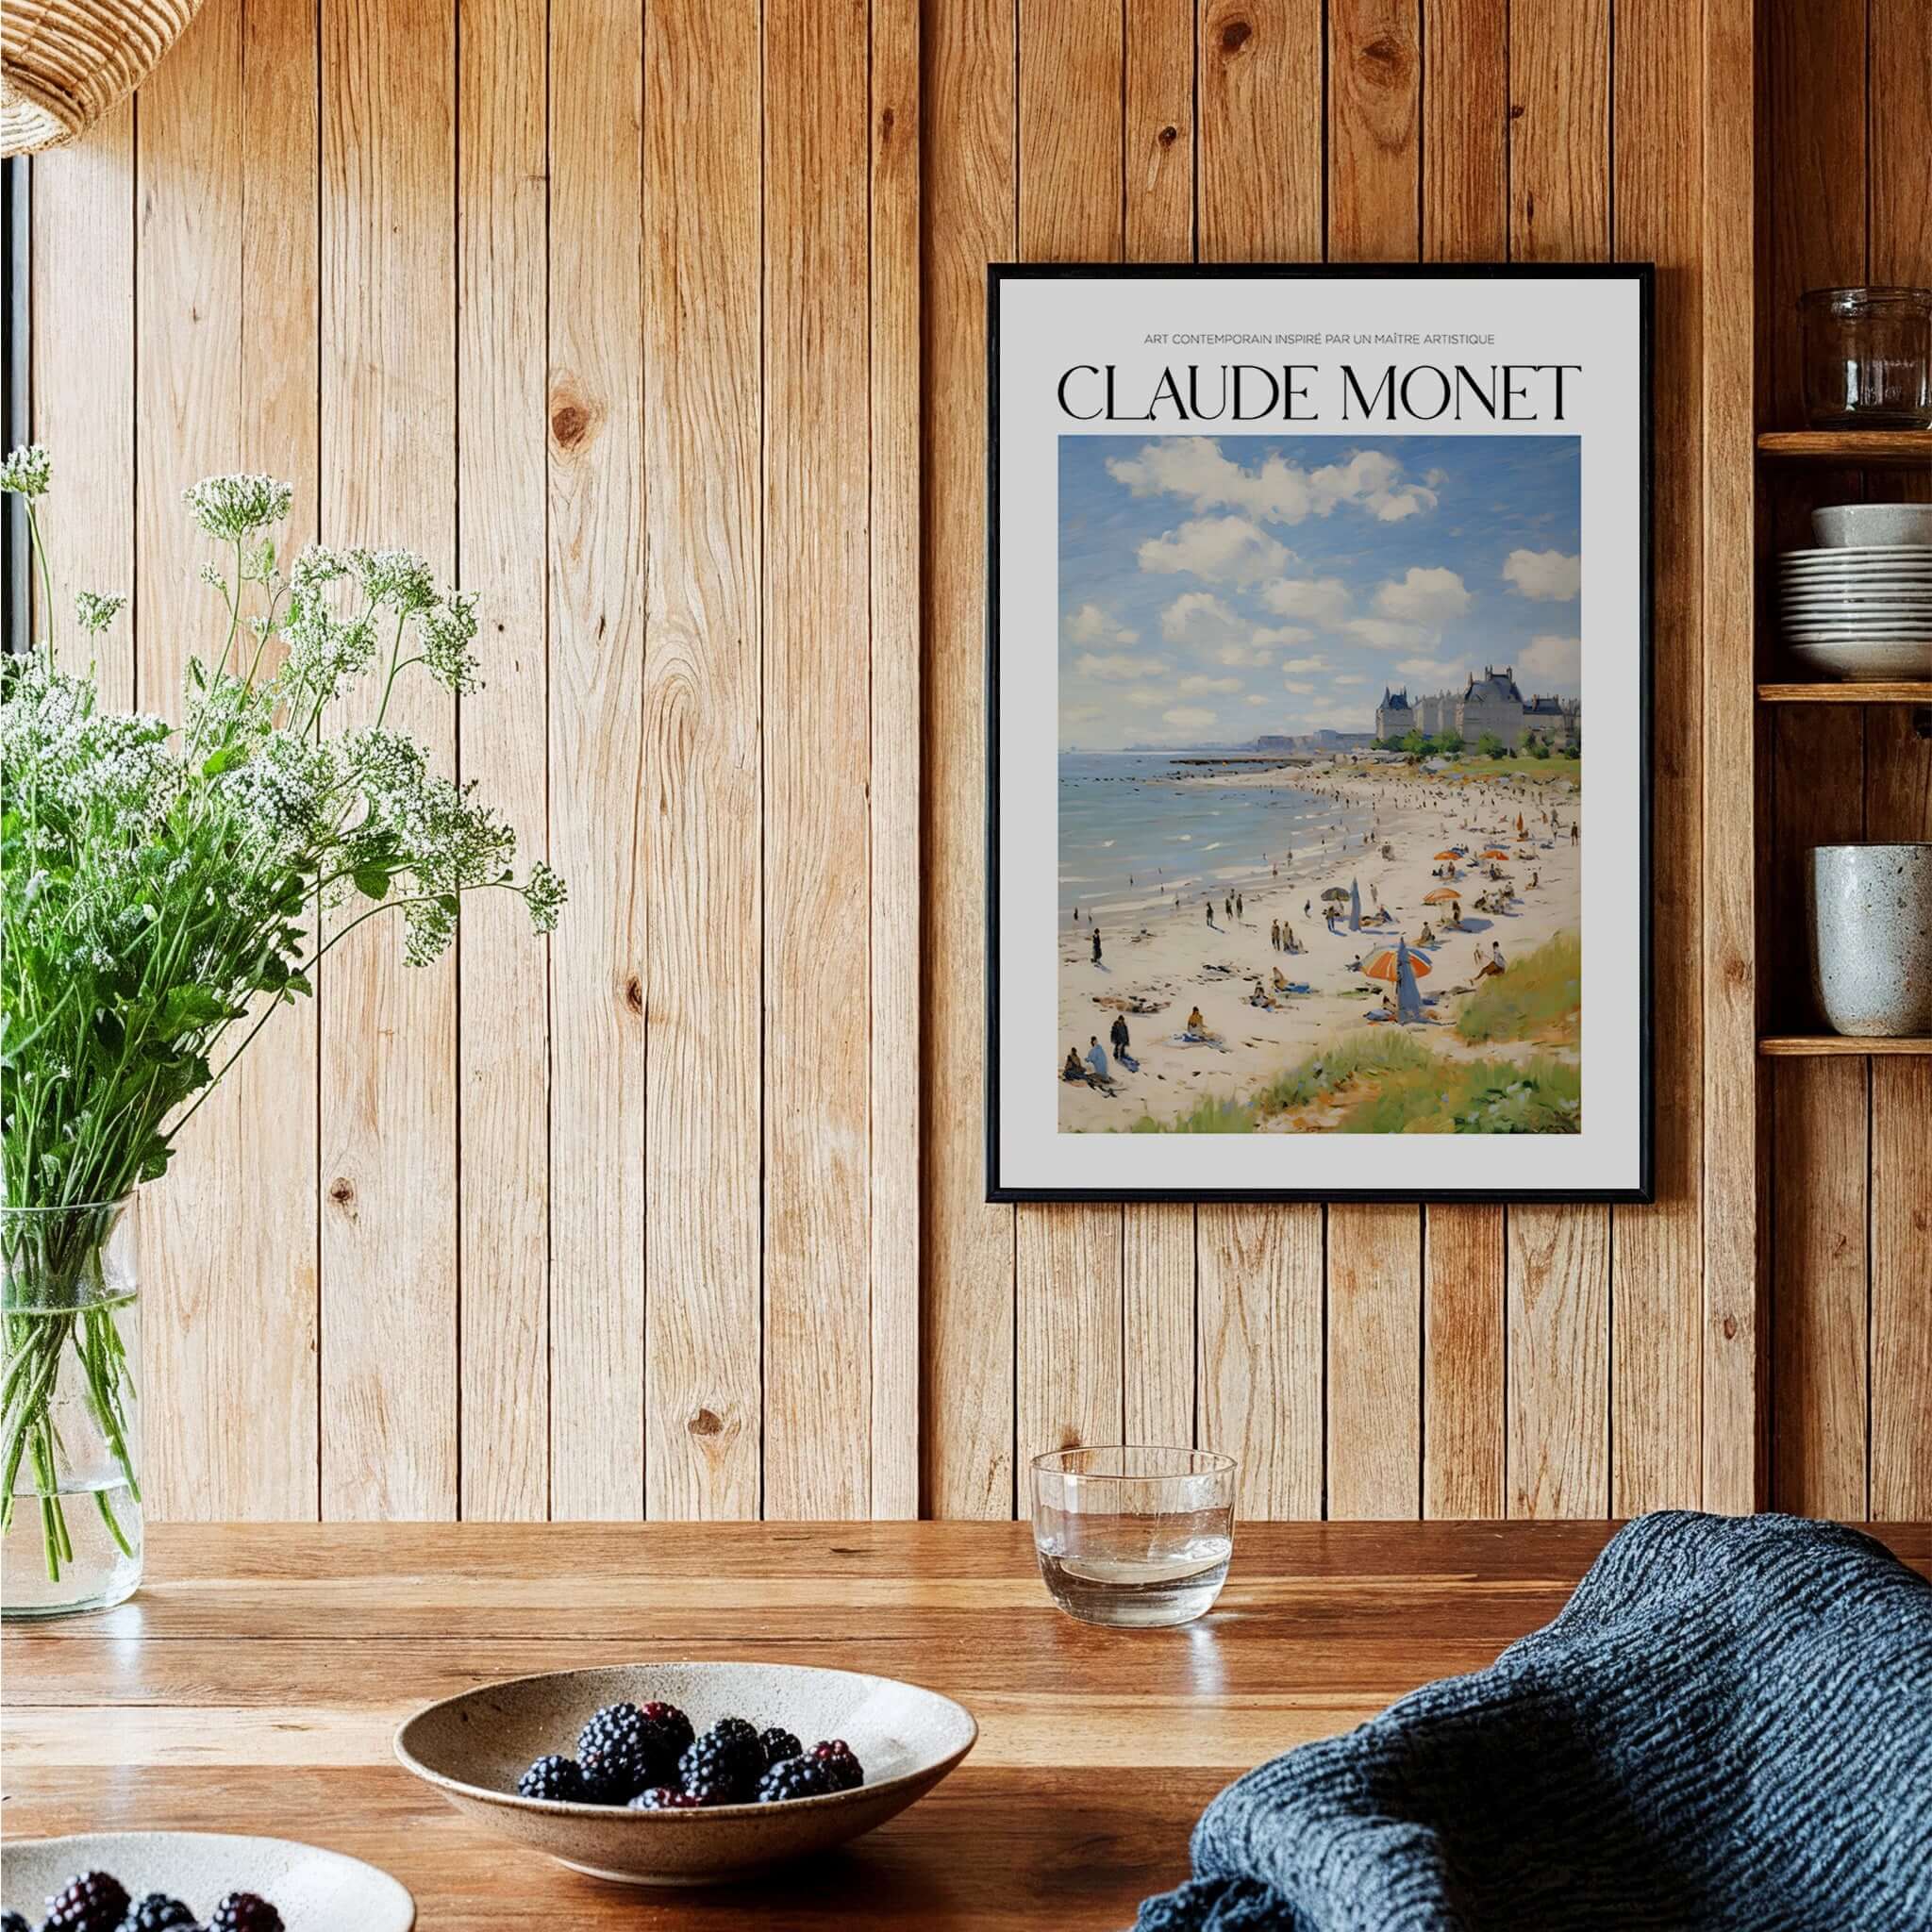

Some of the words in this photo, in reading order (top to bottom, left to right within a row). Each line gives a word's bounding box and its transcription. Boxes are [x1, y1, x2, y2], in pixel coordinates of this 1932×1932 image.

[1143, 333, 1170, 344] ART
[1172, 333, 1273, 344] CONTEMPORAIN
[1274, 330, 1323, 344] INSPIRÉ
[1324, 333, 1351, 344] PAR
[1353, 333, 1373, 344] UN
[1374, 331, 1421, 344] MAÎTRE
[1423, 333, 1495, 345] ARTISTIQUE
[1057, 364, 1319, 421] CLAUDE
[1340, 364, 1583, 421] MONET
